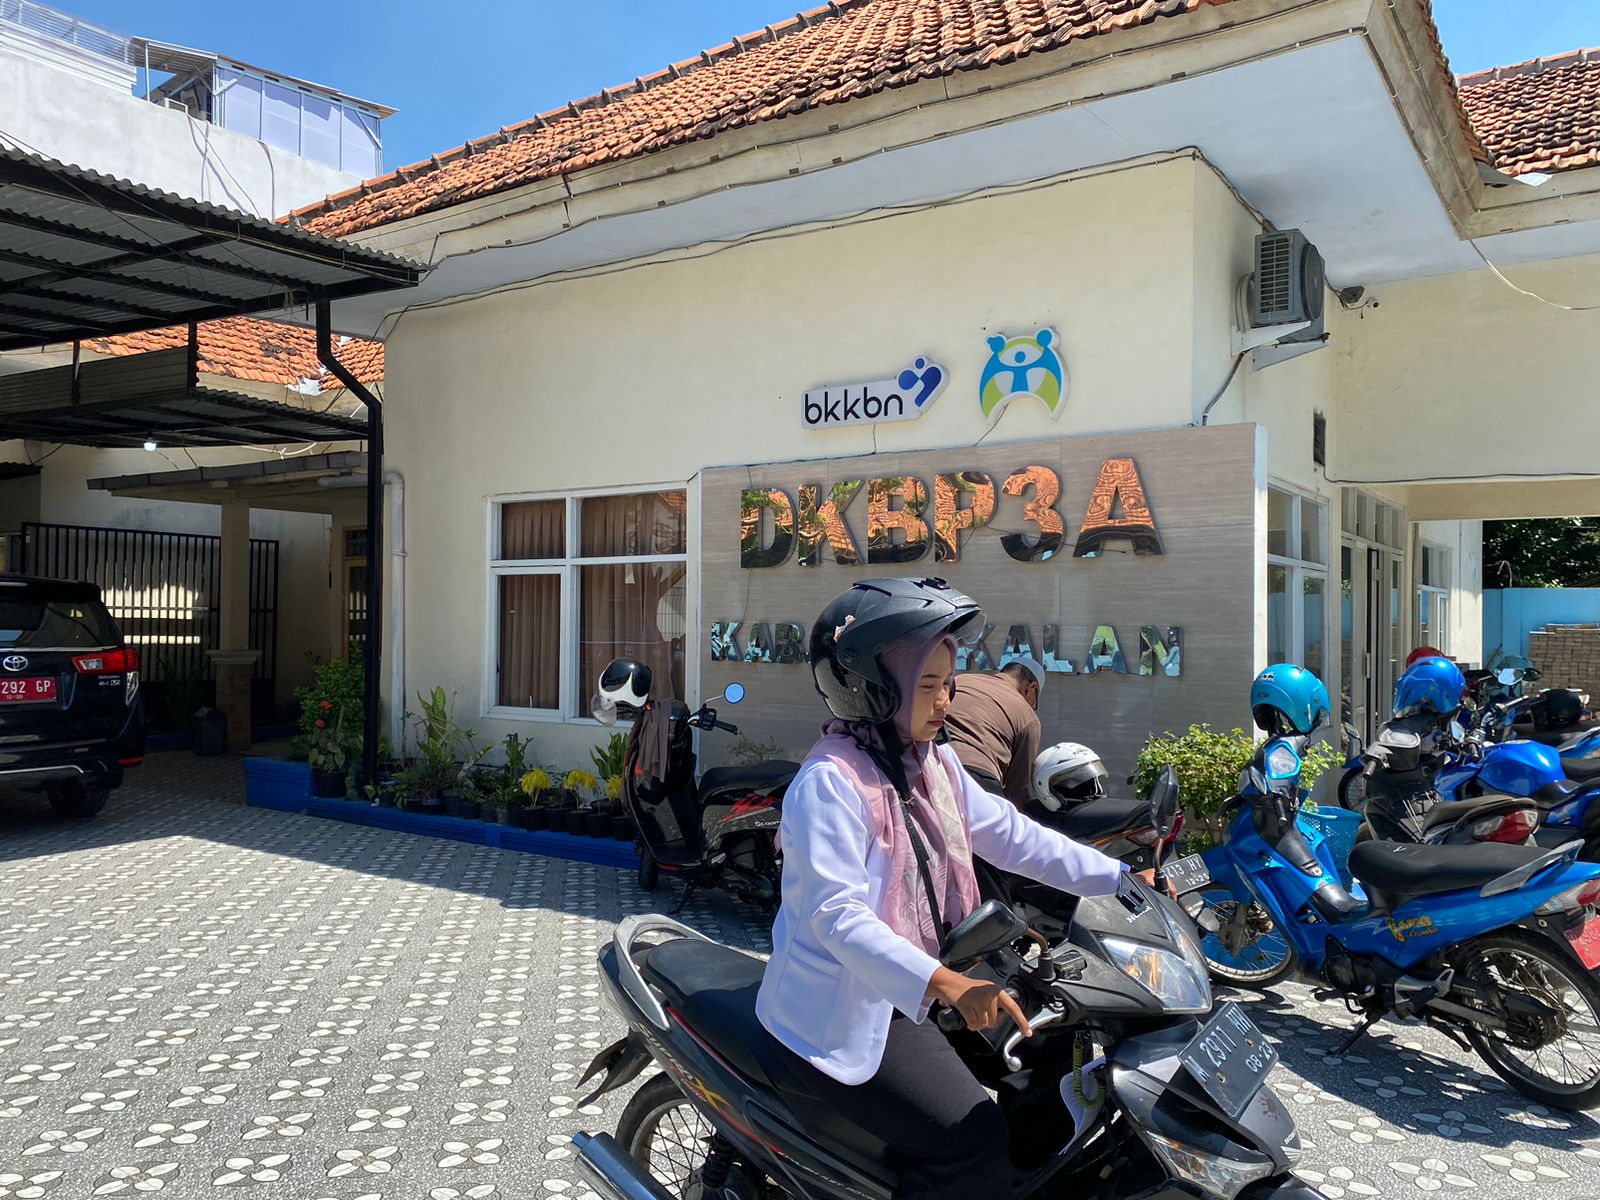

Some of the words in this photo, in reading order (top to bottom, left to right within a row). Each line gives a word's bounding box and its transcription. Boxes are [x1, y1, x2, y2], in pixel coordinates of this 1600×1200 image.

[804, 386, 904, 425] bkkbn
[740, 457, 1165, 569] DKBP3A
[36, 680, 51, 692] GP
[1187, 857, 1202, 871] HY
